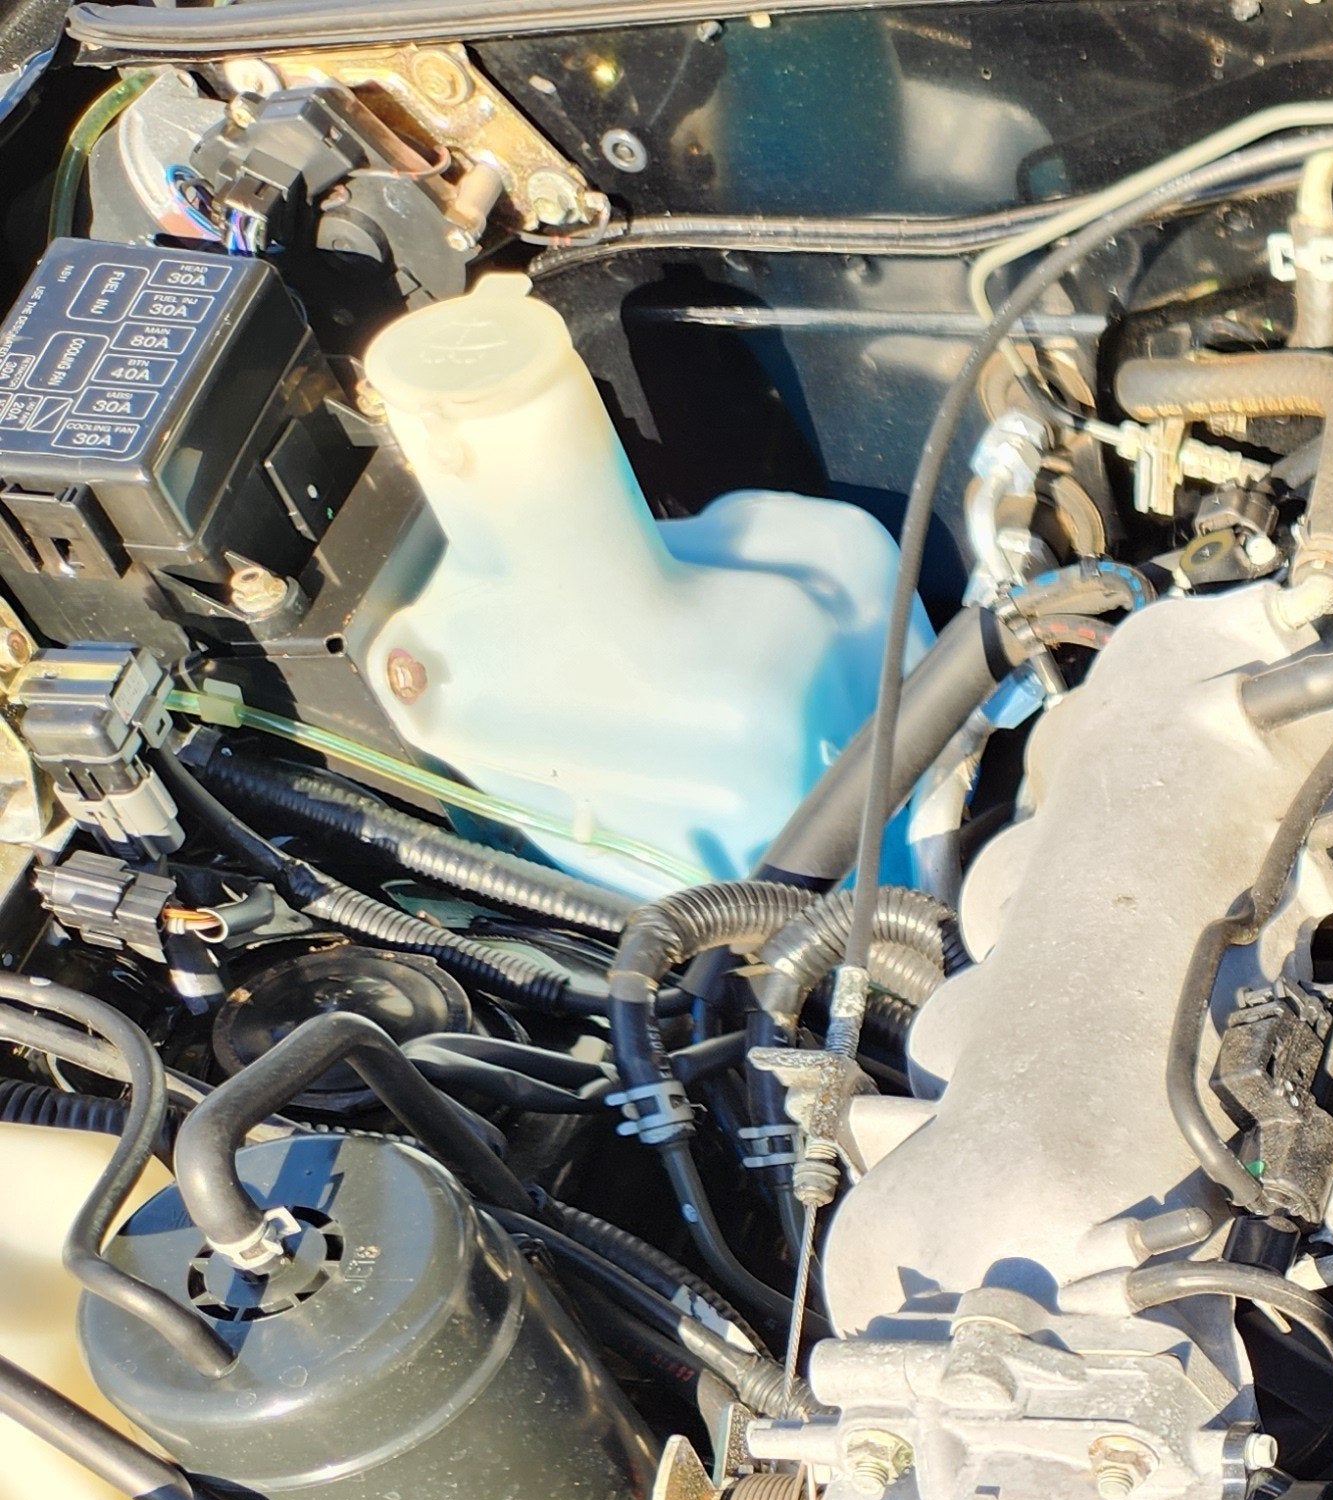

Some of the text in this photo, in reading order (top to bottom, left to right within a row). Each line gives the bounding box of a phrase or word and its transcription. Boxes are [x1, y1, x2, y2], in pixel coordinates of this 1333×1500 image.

[180, 264, 208, 273] HEAD
[167, 273, 206, 286] 30A
[90, 271, 126, 315] FUEL INJ
[154, 295, 177, 303] FUEL
[20, 286, 46, 316] USE THE
[149, 304, 188, 317] 30A
[144, 327, 171, 335] MAIN
[130, 335, 169, 349] 80A
[47, 338, 86, 387] COOLING FAN
[110, 367, 150, 381] 40A
[5, 402, 25, 421] 20A
[93, 399, 132, 414] 30A
[66, 422, 135, 434] COOLING FAN
[72, 432, 112, 447] 30A
